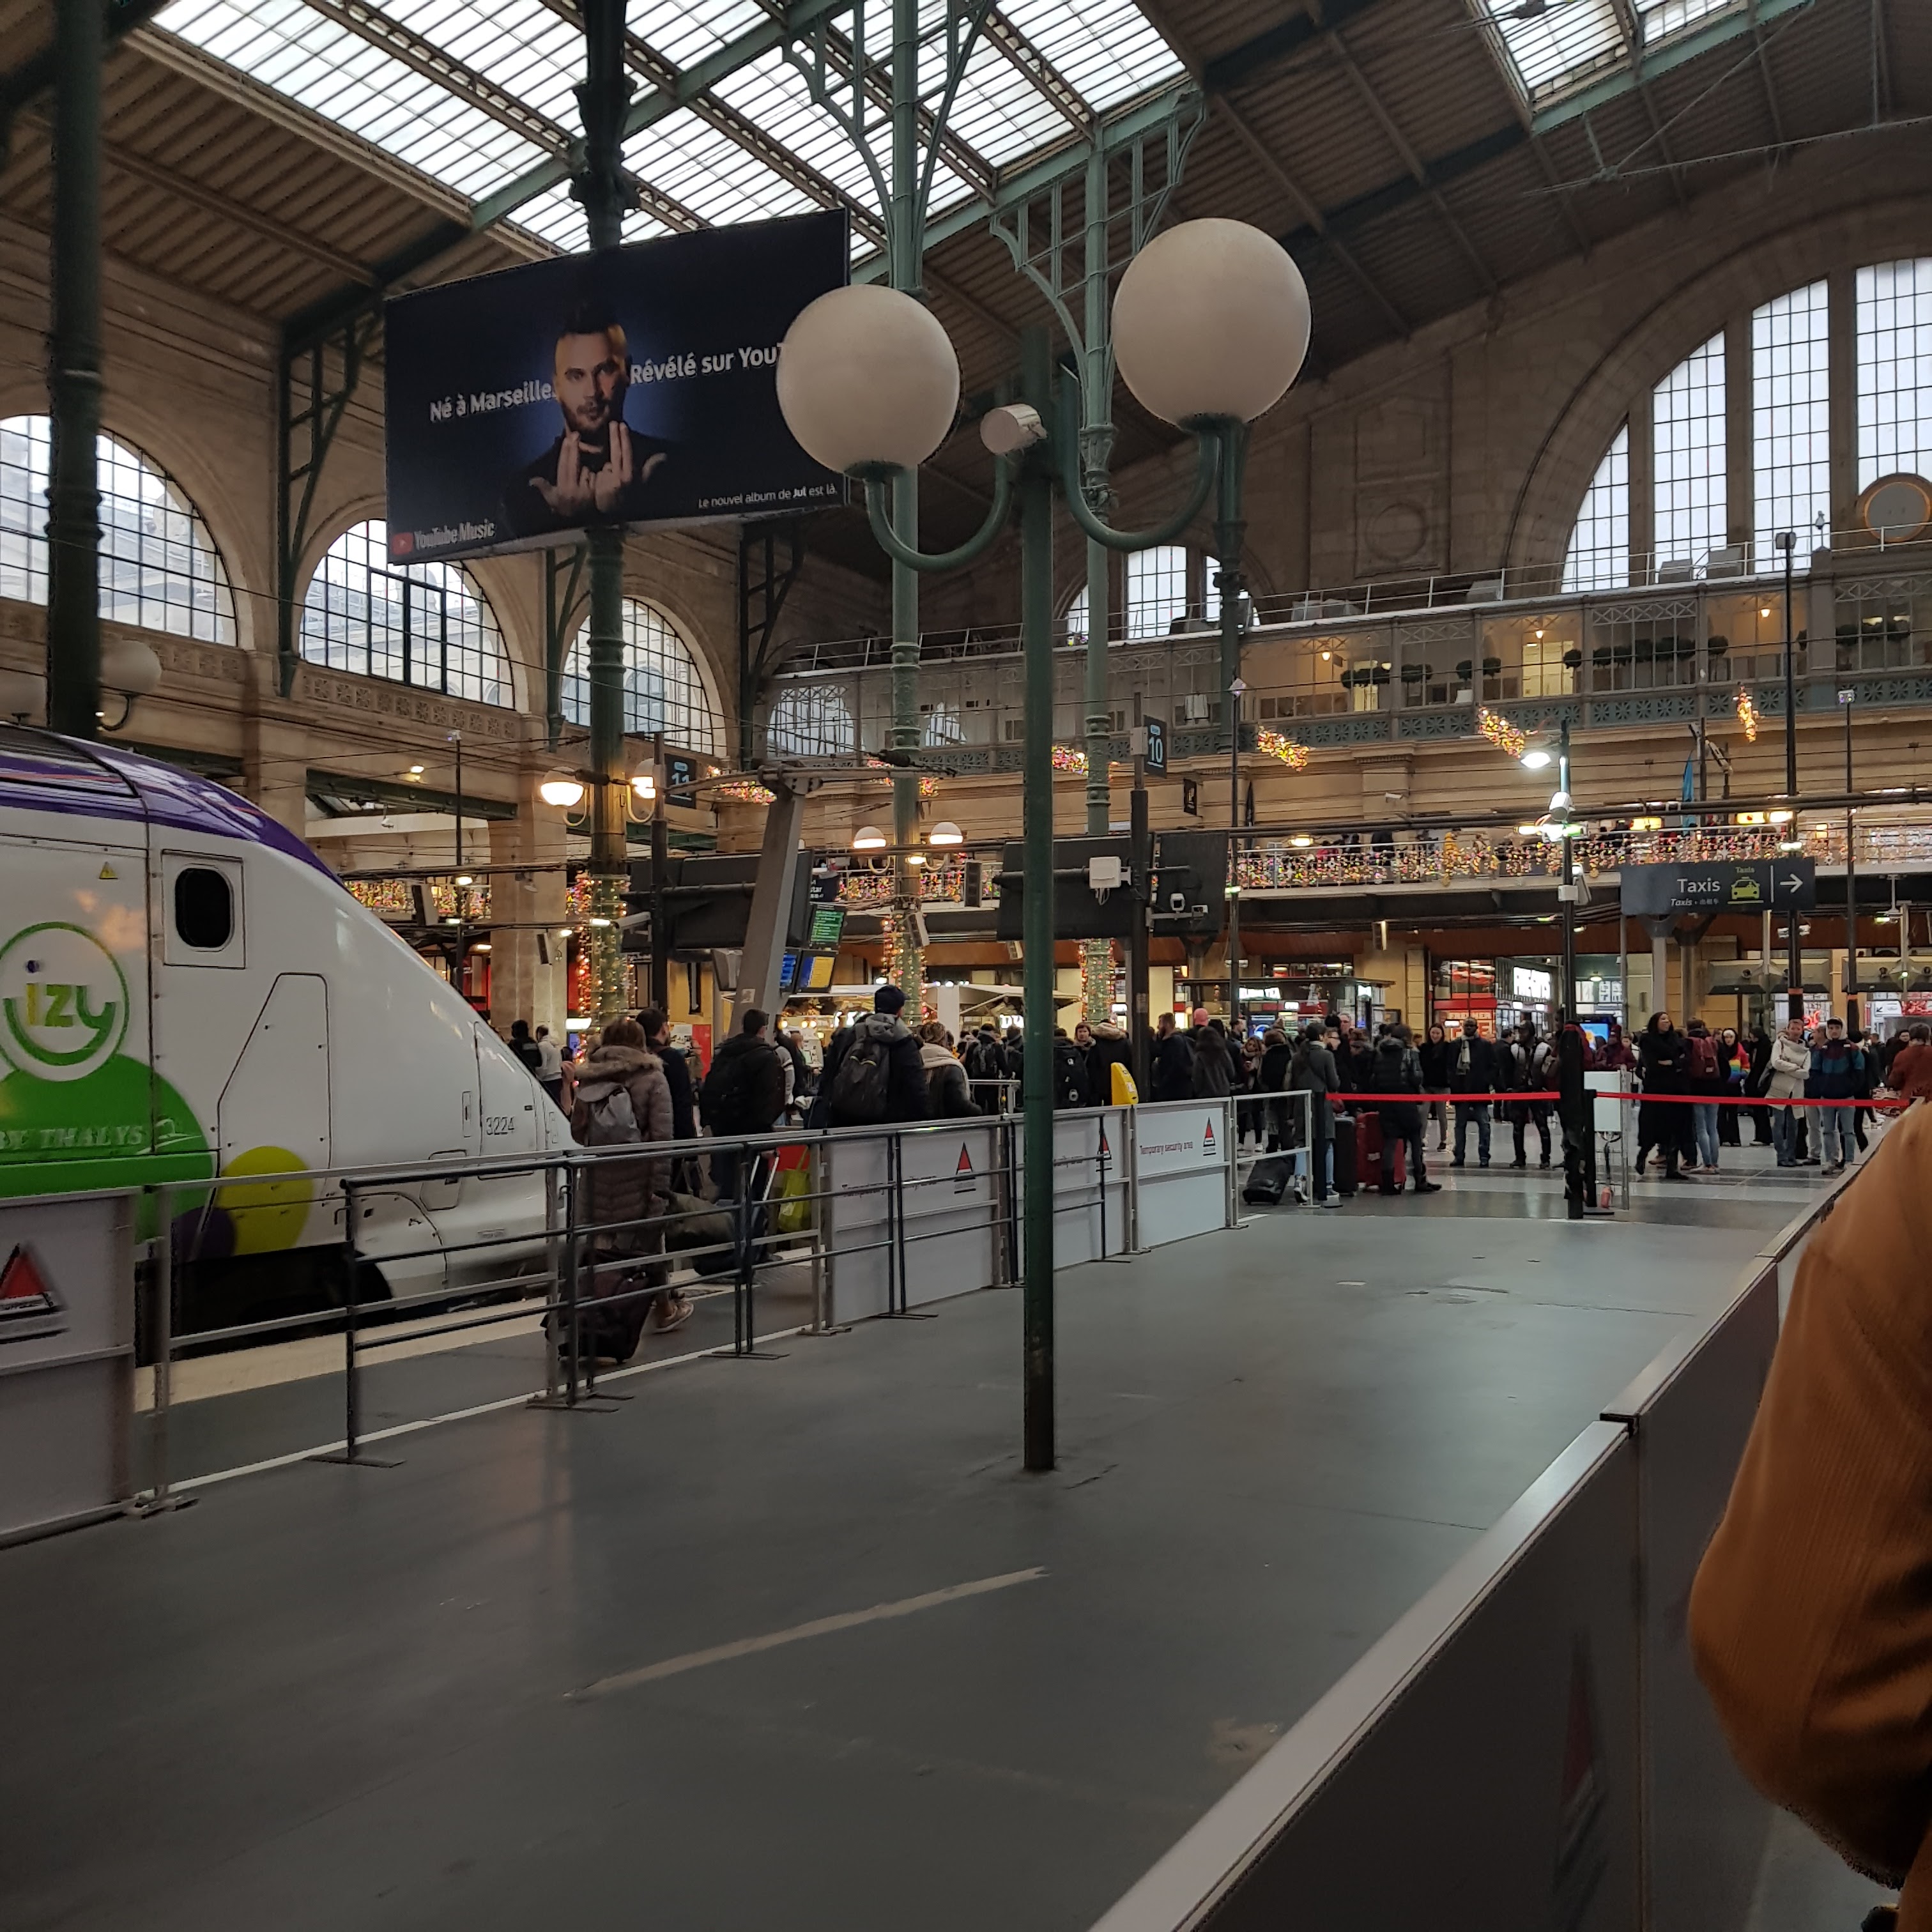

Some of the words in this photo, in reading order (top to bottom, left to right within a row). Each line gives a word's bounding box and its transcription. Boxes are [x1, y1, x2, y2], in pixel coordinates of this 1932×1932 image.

[630, 351, 696, 384] Révélé
[702, 353, 735, 374] sur
[738, 342, 785, 368] You
[430, 396, 452, 422] Né
[456, 393, 466, 416] à
[698, 498, 710, 508] Le
[711, 493, 743, 507] nouvel
[745, 491, 776, 503] album
[778, 489, 791, 500] de
[793, 486, 807, 498] Jul
[809, 486, 824, 496] est
[414, 525, 458, 550] YouTube
[457, 518, 496, 541] Music
[1149, 737, 1163, 763] 10
[1676, 877, 1721, 893] Taxis
[1670, 898, 1692, 907] Taxis
[40, 1125, 142, 1149] THALYS
[486, 1116, 515, 1135] 3224
